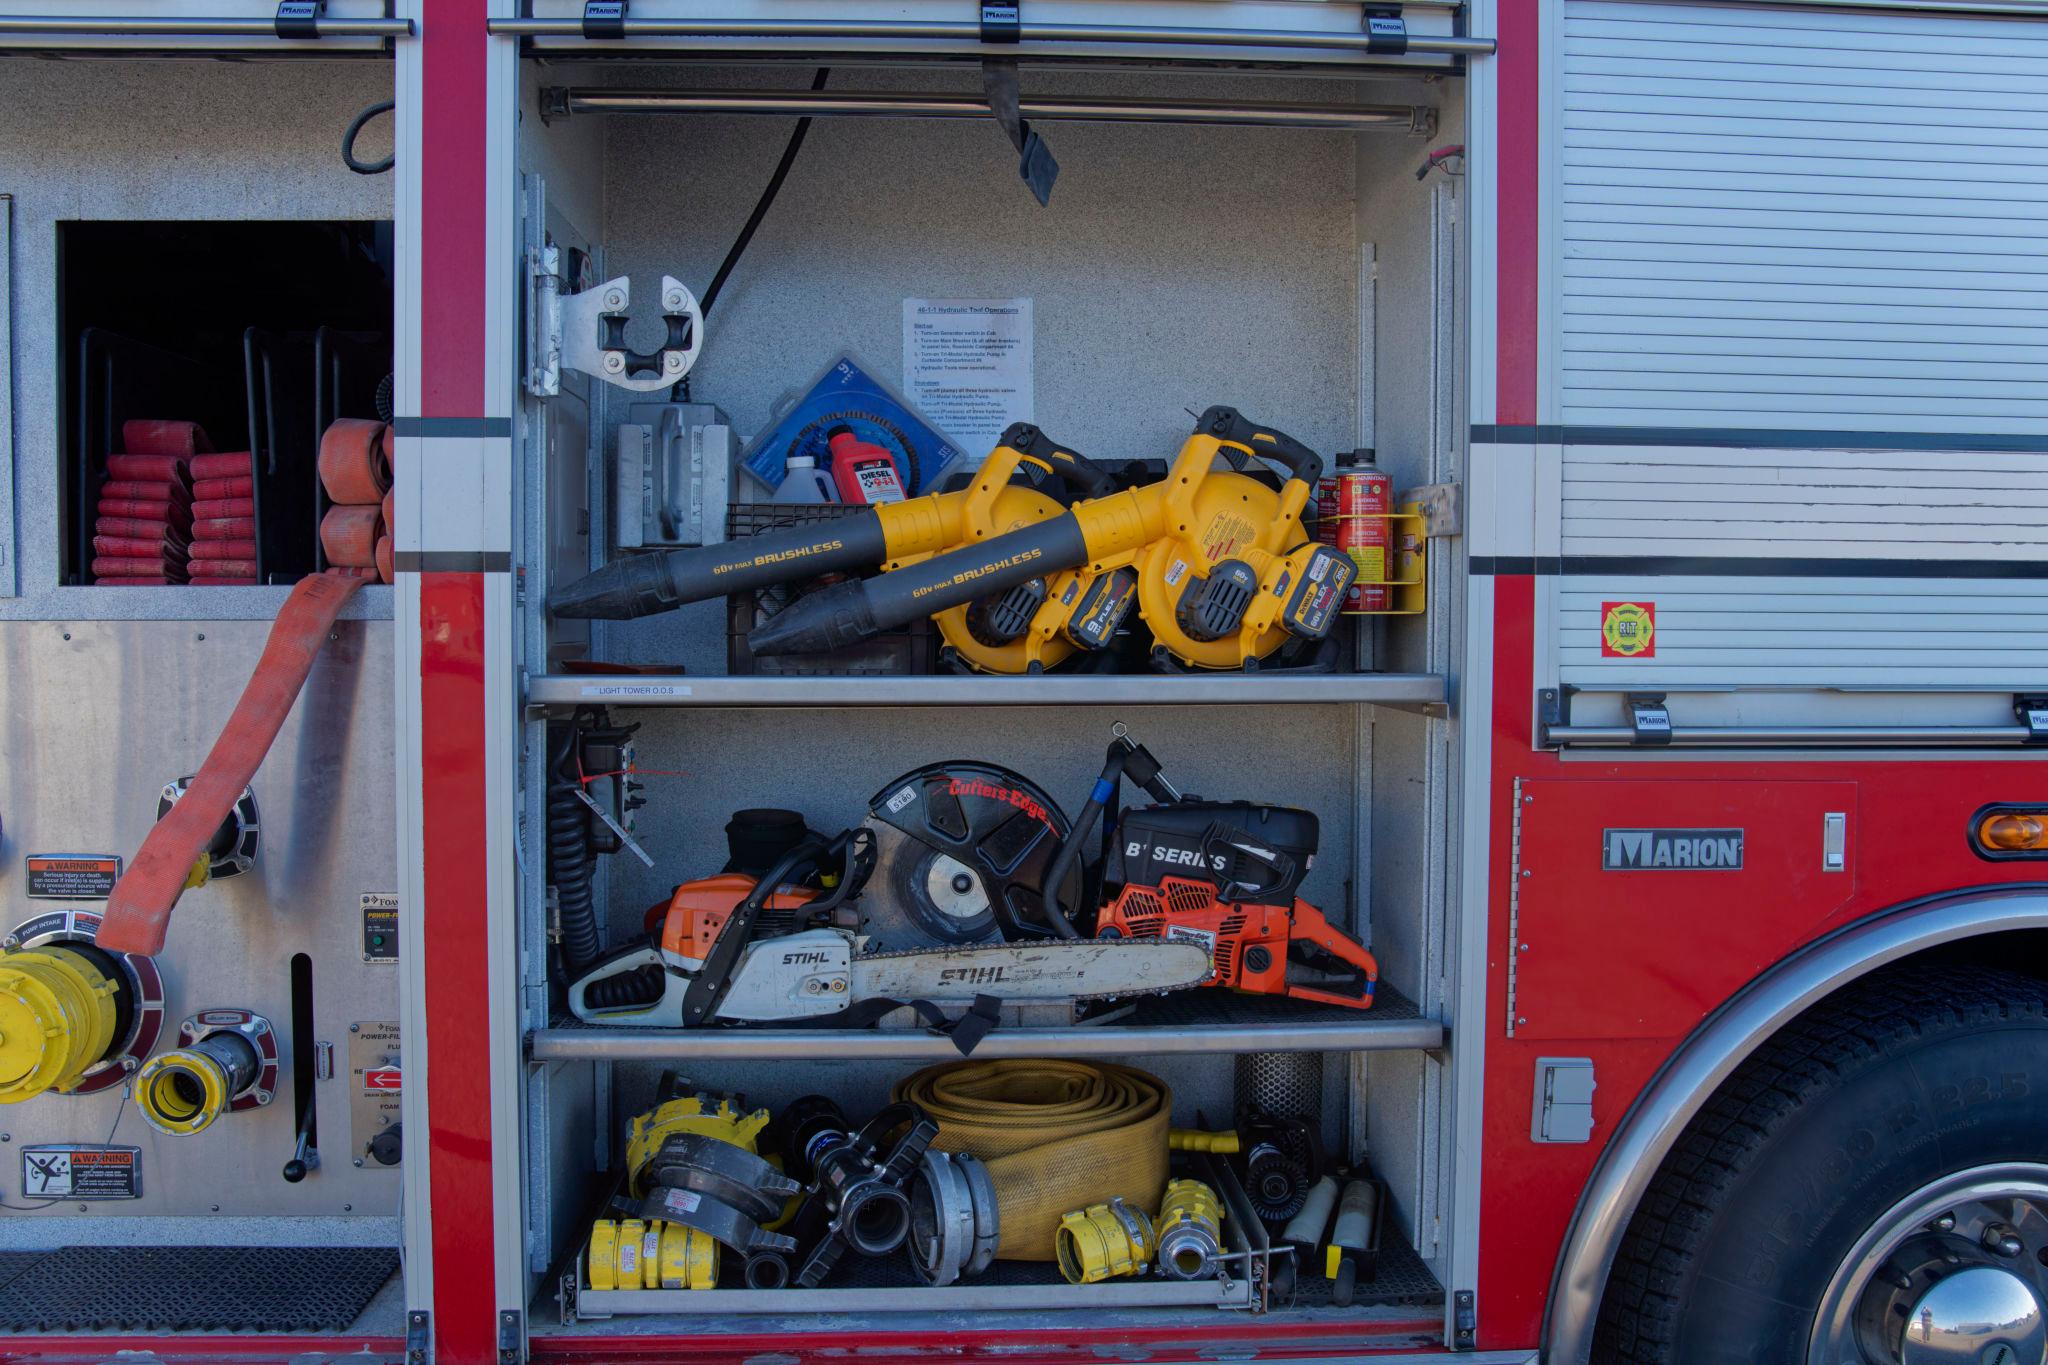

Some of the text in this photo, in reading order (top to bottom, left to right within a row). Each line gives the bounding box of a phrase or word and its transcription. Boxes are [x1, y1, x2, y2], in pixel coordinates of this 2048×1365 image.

[860, 470, 891, 480] DIESEL
[735, 561, 752, 569] MAX
[754, 540, 843, 566] BRUSHLESS
[934, 580, 952, 590] MAX
[953, 548, 1043, 585] BRUSHLESS
[1098, 599, 1116, 623] FLEX
[1619, 622, 1637, 634] RIT
[1639, 716, 1667, 724] MARION
[949, 777, 1047, 819] Cutters Edge
[1609, 832, 1738, 867] MARION
[22, 918, 62, 937] PUMP INTAKE
[783, 952, 830, 965] STIHL
[940, 966, 1010, 984] STIHL
[1931, 1072, 2031, 1109] 22.5
[83, 1153, 130, 1163] WARNING
